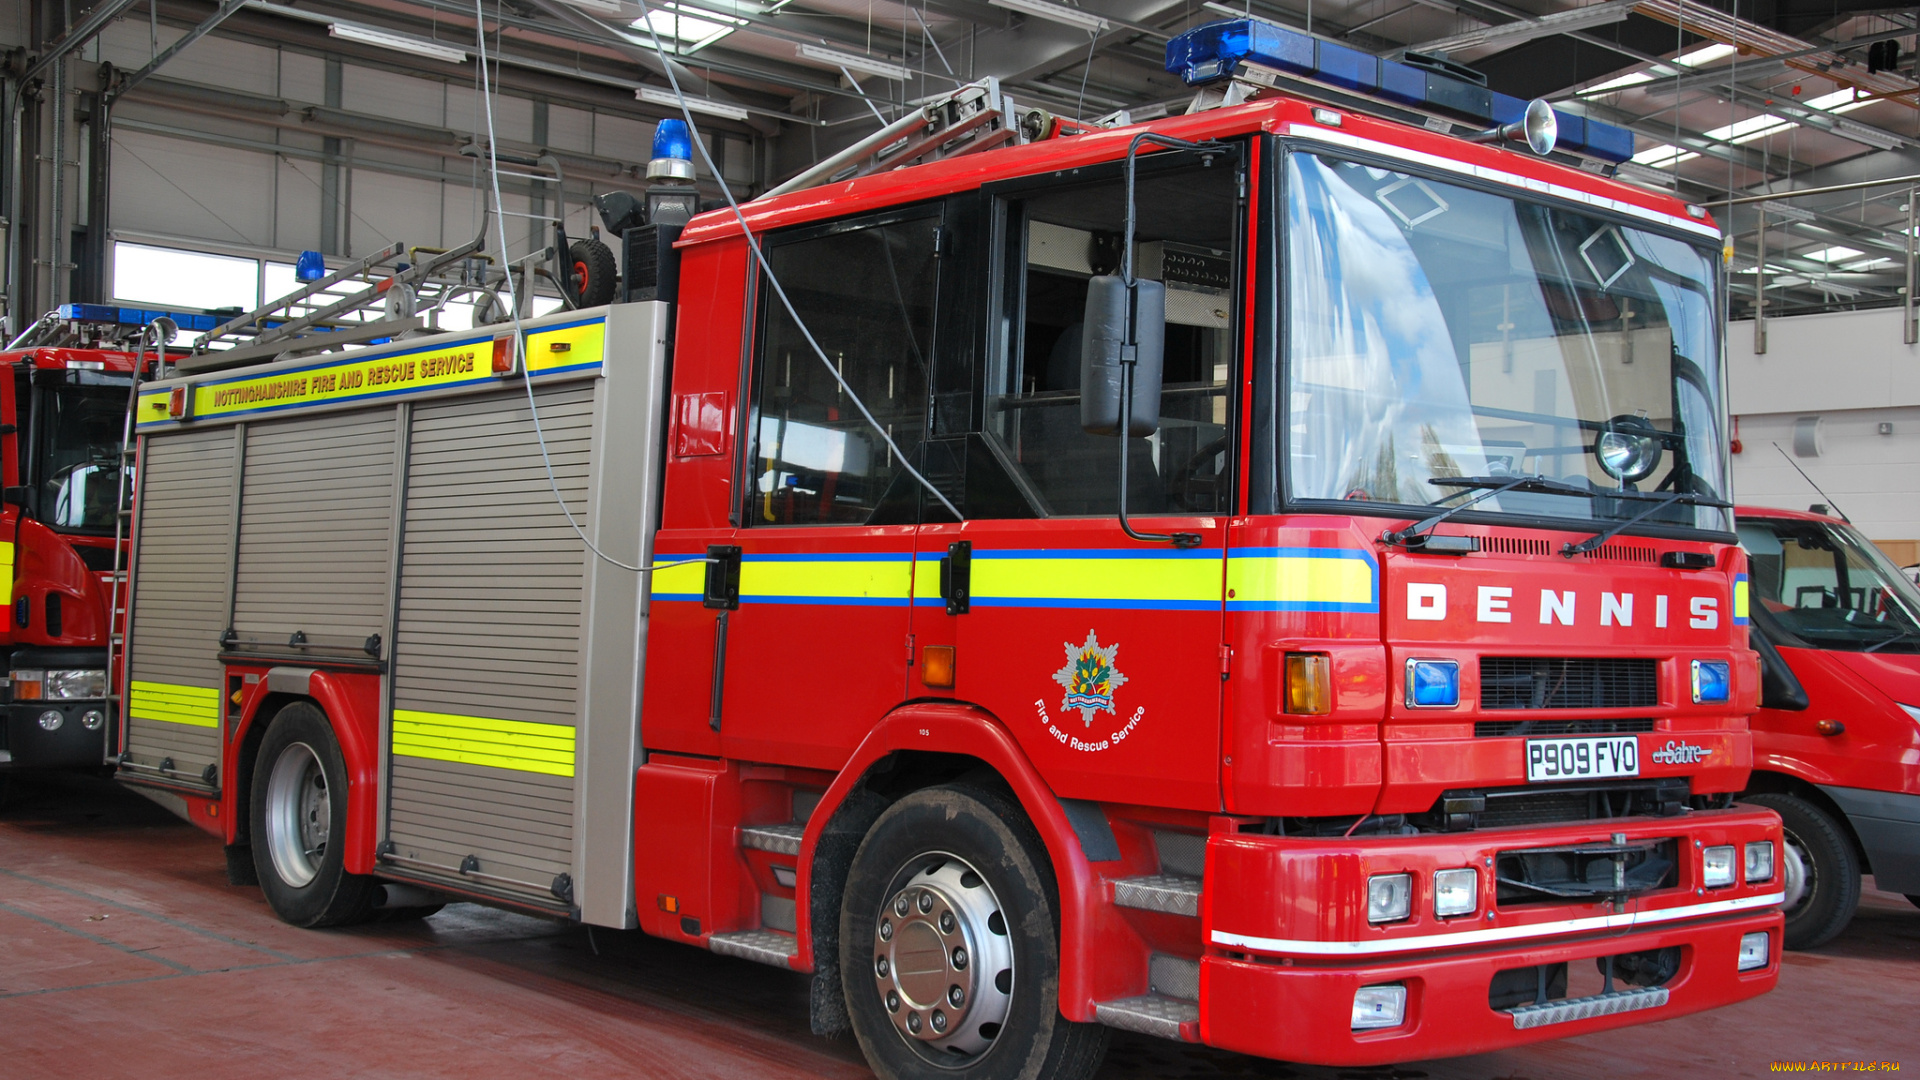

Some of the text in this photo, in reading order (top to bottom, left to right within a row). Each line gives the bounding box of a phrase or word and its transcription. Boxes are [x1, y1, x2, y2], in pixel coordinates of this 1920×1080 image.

[214, 352, 474, 407] NOTTINGHAMSHIRE FIRE AND RESCUE SERVICE
[1407, 582, 1718, 630] DENNIS
[1034, 698, 1145, 752] Fire and Rescue Service
[1529, 741, 1636, 777] P909 FVO
[1664, 740, 1702, 765] Sabre
